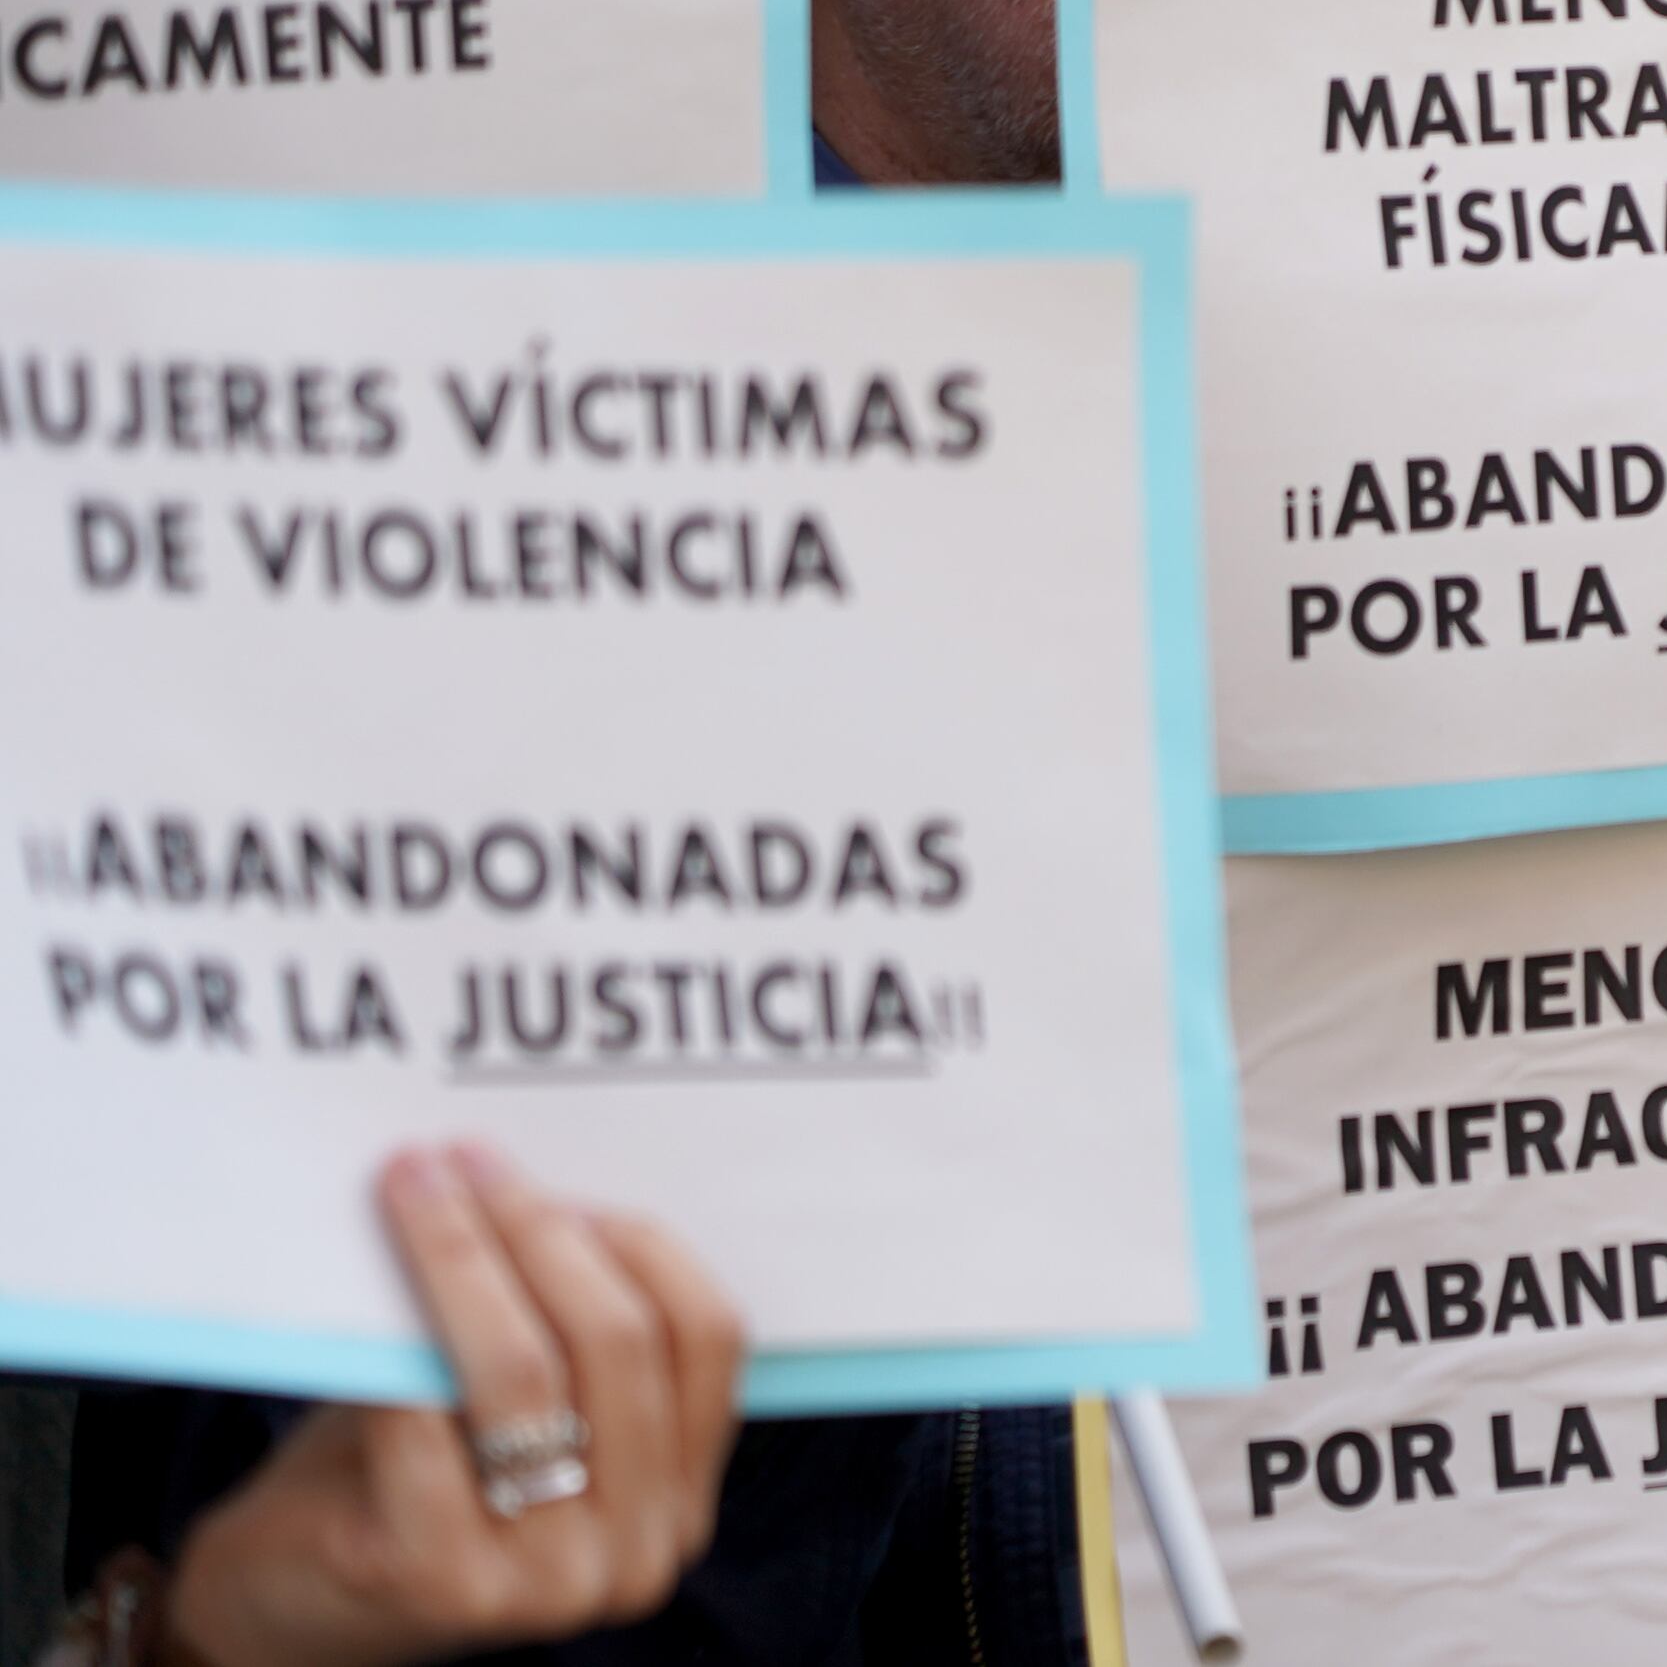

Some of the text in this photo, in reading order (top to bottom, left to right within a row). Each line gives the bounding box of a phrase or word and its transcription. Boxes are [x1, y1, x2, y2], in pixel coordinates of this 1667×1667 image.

[0, 338, 990, 464] UJERES VÍCTIMAS
[70, 498, 850, 604] DE VIOLENCIA
[1290, 576, 1484, 660] POR
[1521, 565, 1627, 643] LA
[44, 942, 250, 1052] POR
[282, 964, 405, 1052] LA
[1247, 1421, 1455, 1518] POR
[1490, 1404, 1612, 1490] LA
